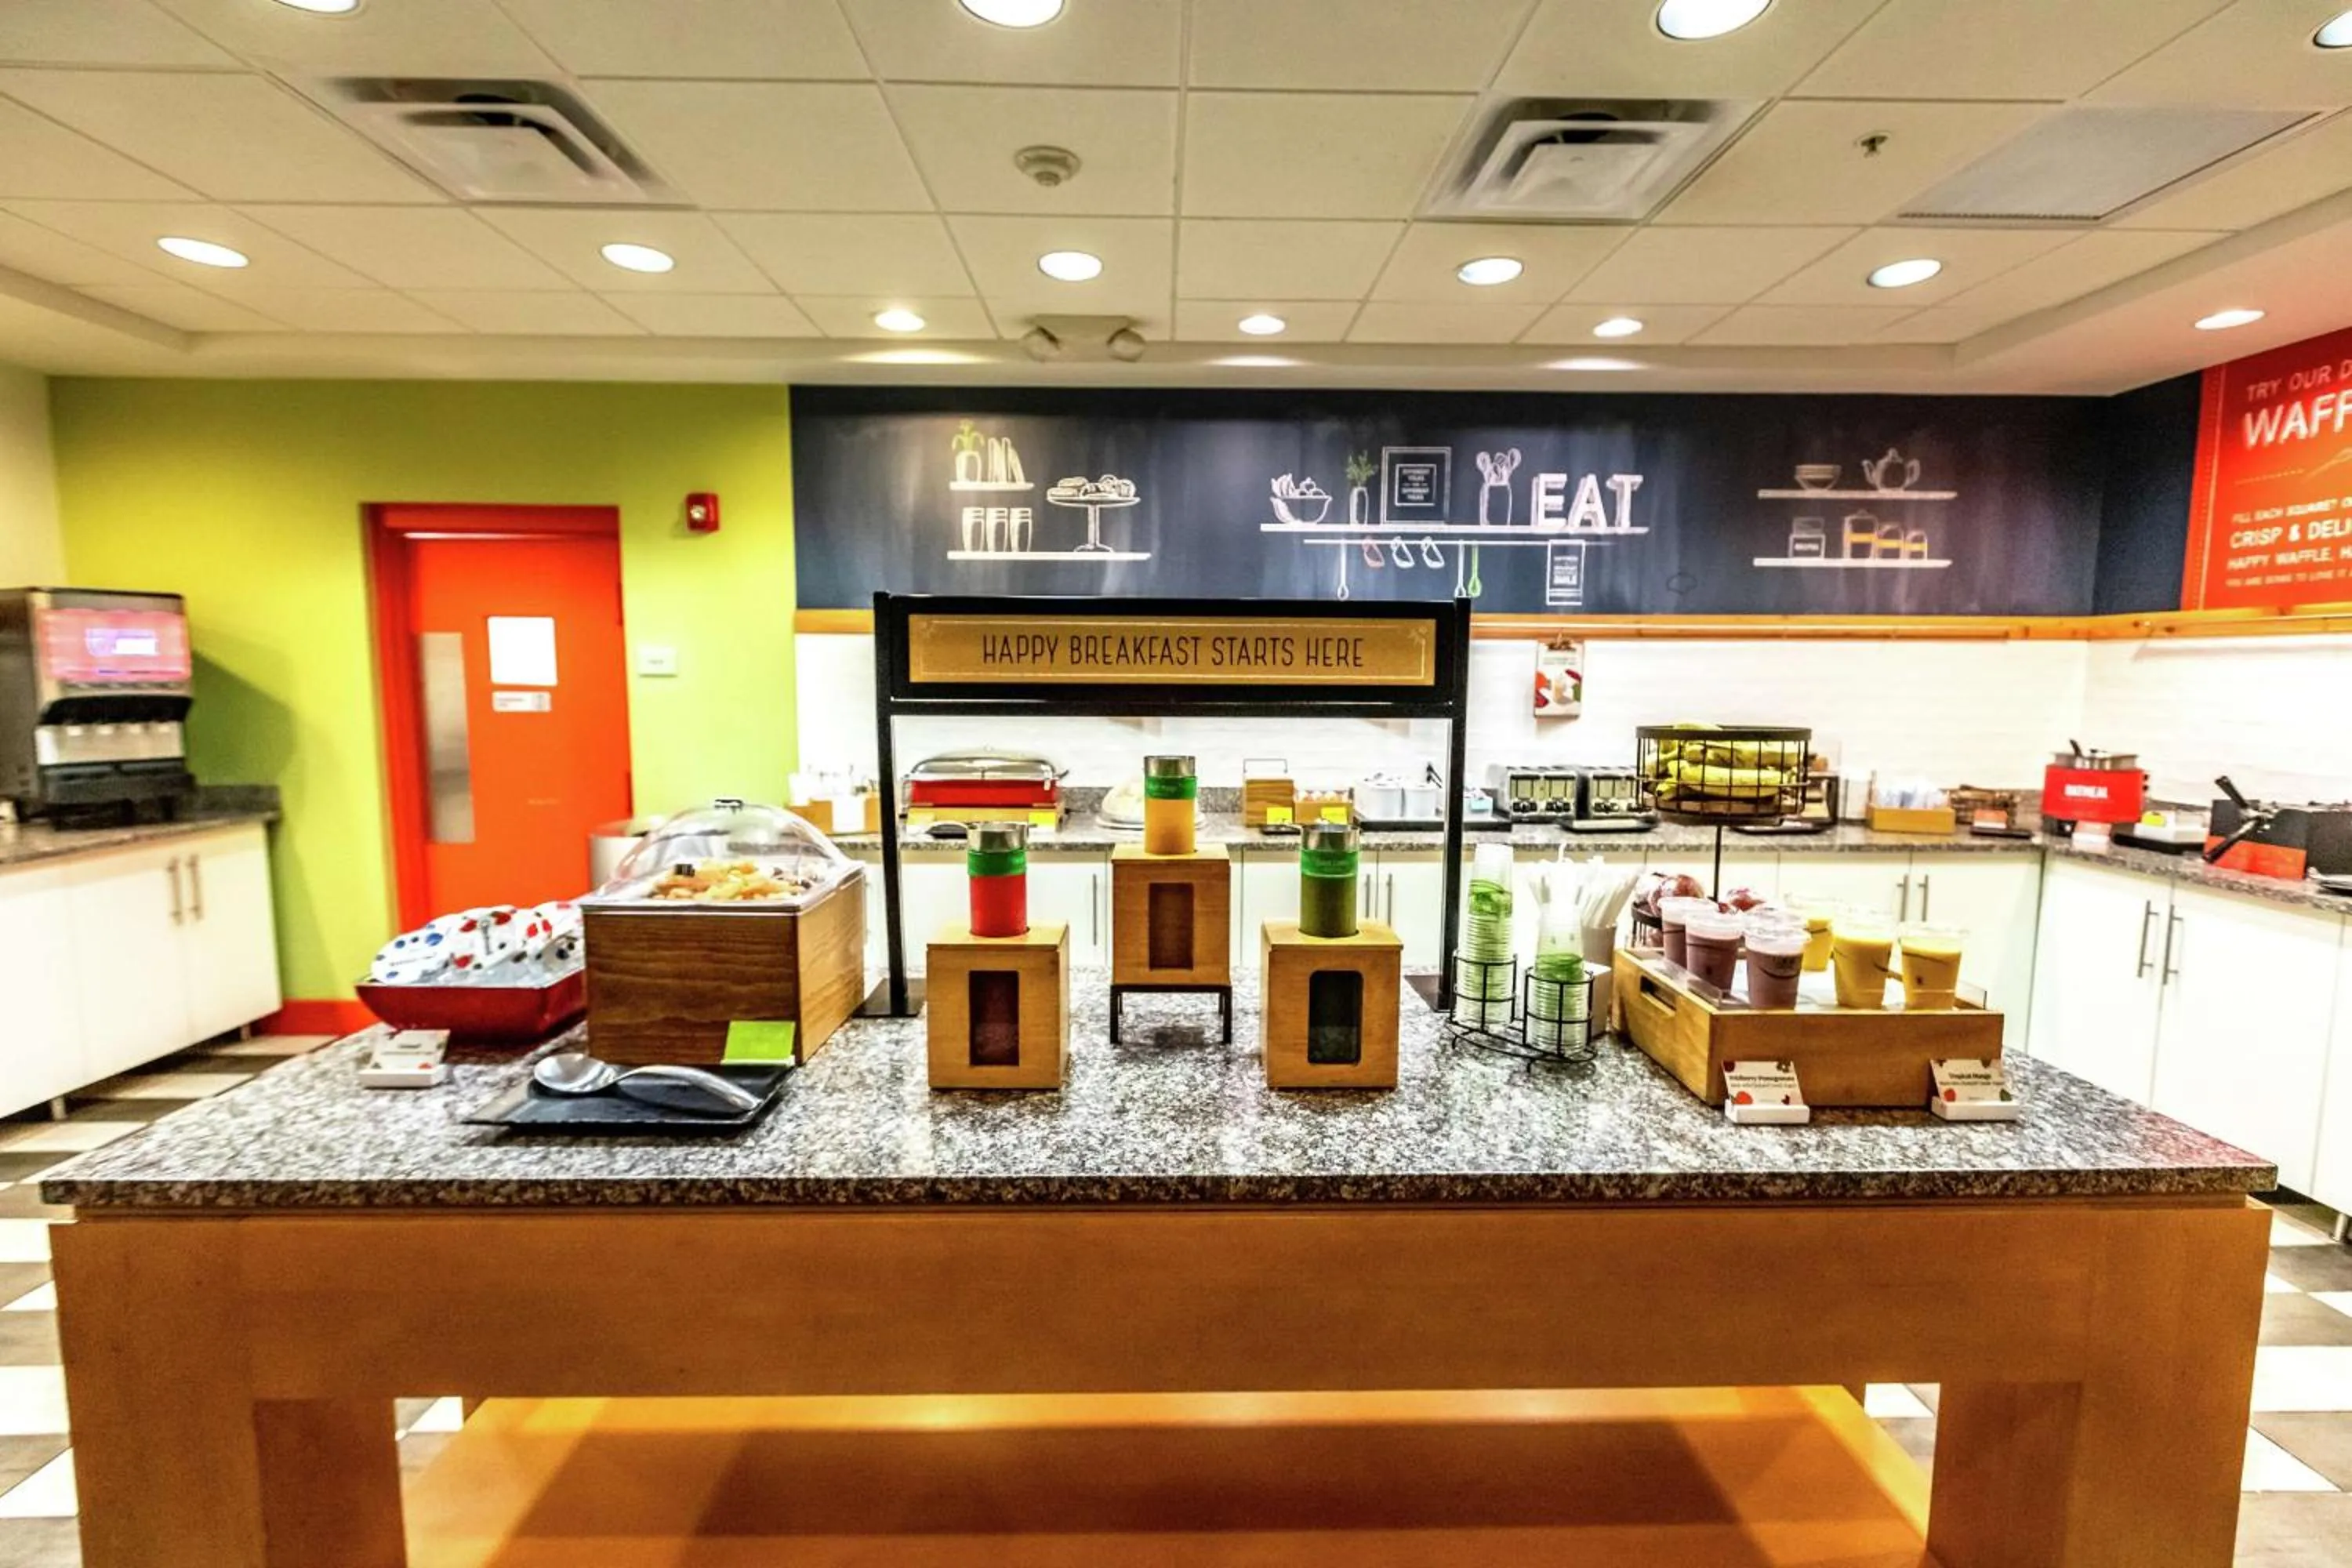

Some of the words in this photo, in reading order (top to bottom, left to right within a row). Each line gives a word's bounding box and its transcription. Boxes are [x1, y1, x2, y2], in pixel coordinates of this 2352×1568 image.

[2246, 378, 2282, 401] TRY
[2288, 365, 2332, 391] OUR
[1530, 473, 1644, 534] EAT
[2229, 526, 2283, 549] CRISP
[982, 633, 1058, 664] HAPPY
[1069, 635, 1201, 666] BREAKFAST
[1211, 637, 1294, 666] STARTS
[1306, 637, 1364, 667] HERE
